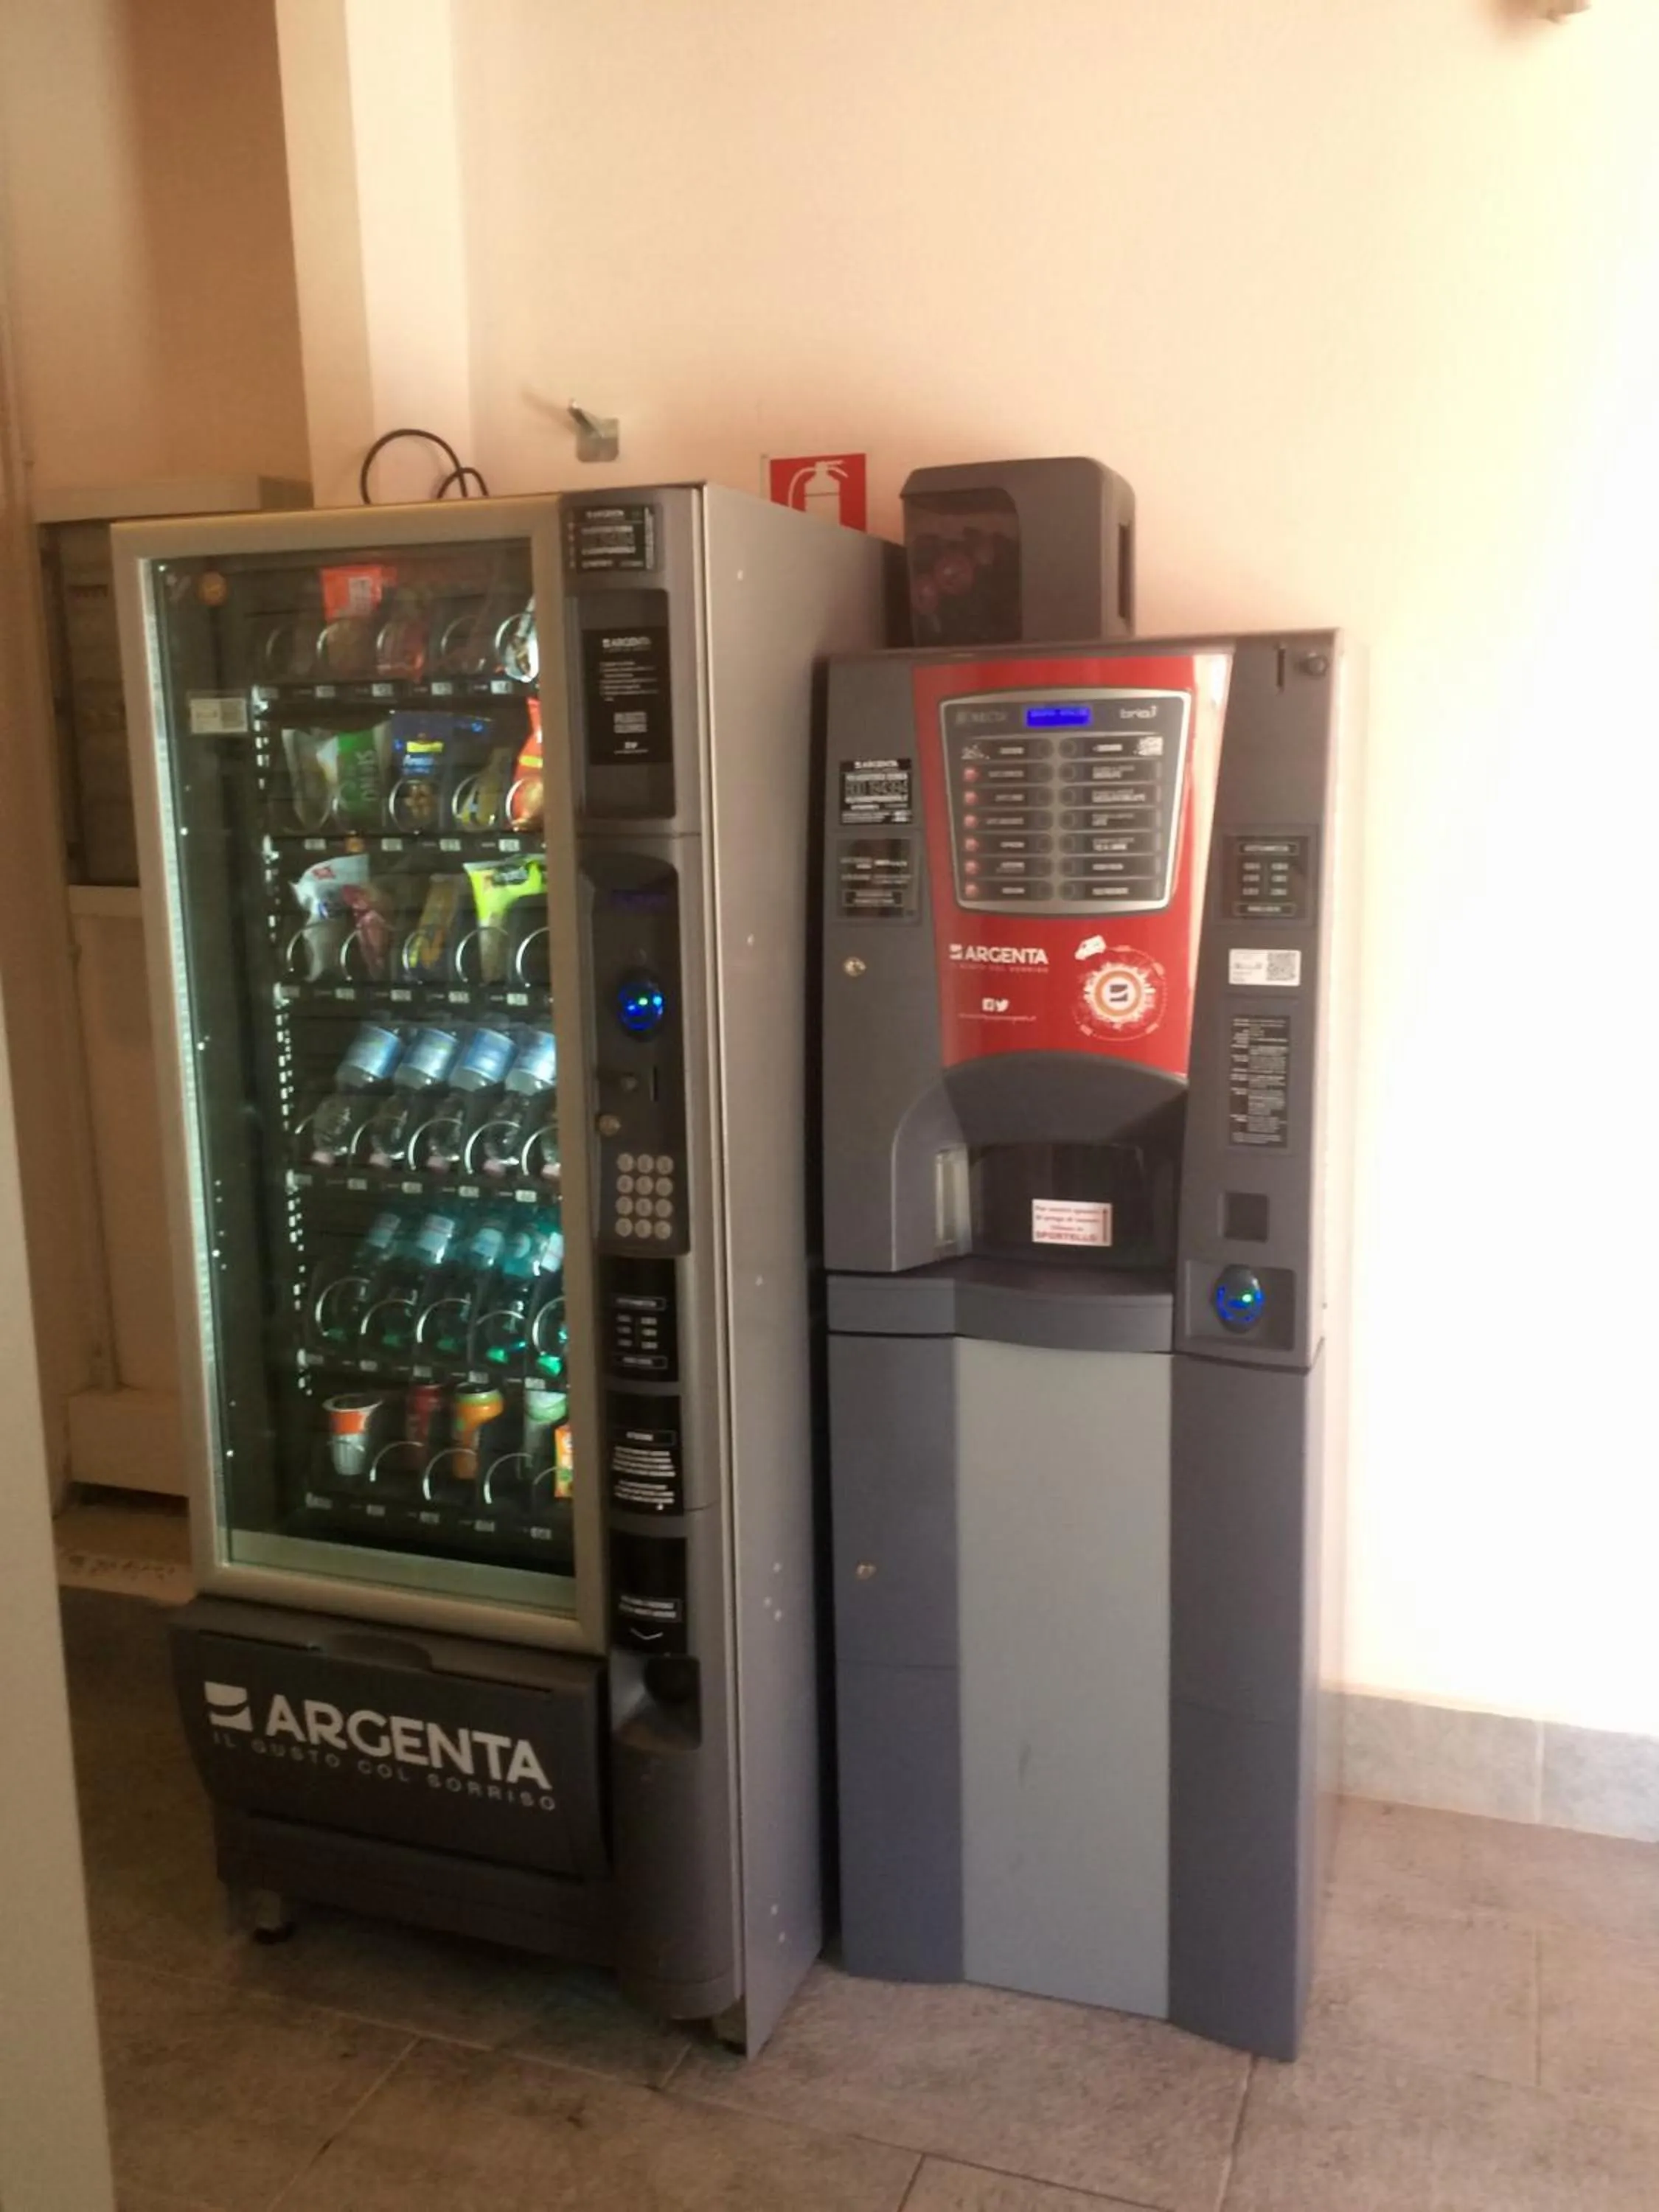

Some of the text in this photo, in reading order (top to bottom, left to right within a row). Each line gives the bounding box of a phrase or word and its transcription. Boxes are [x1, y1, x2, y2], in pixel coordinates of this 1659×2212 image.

[964, 945, 1048, 965] ARGENTA
[212, 1731, 557, 1813] IL GUSTO COL SORRISO
[266, 1694, 552, 1790] ARGENTA
